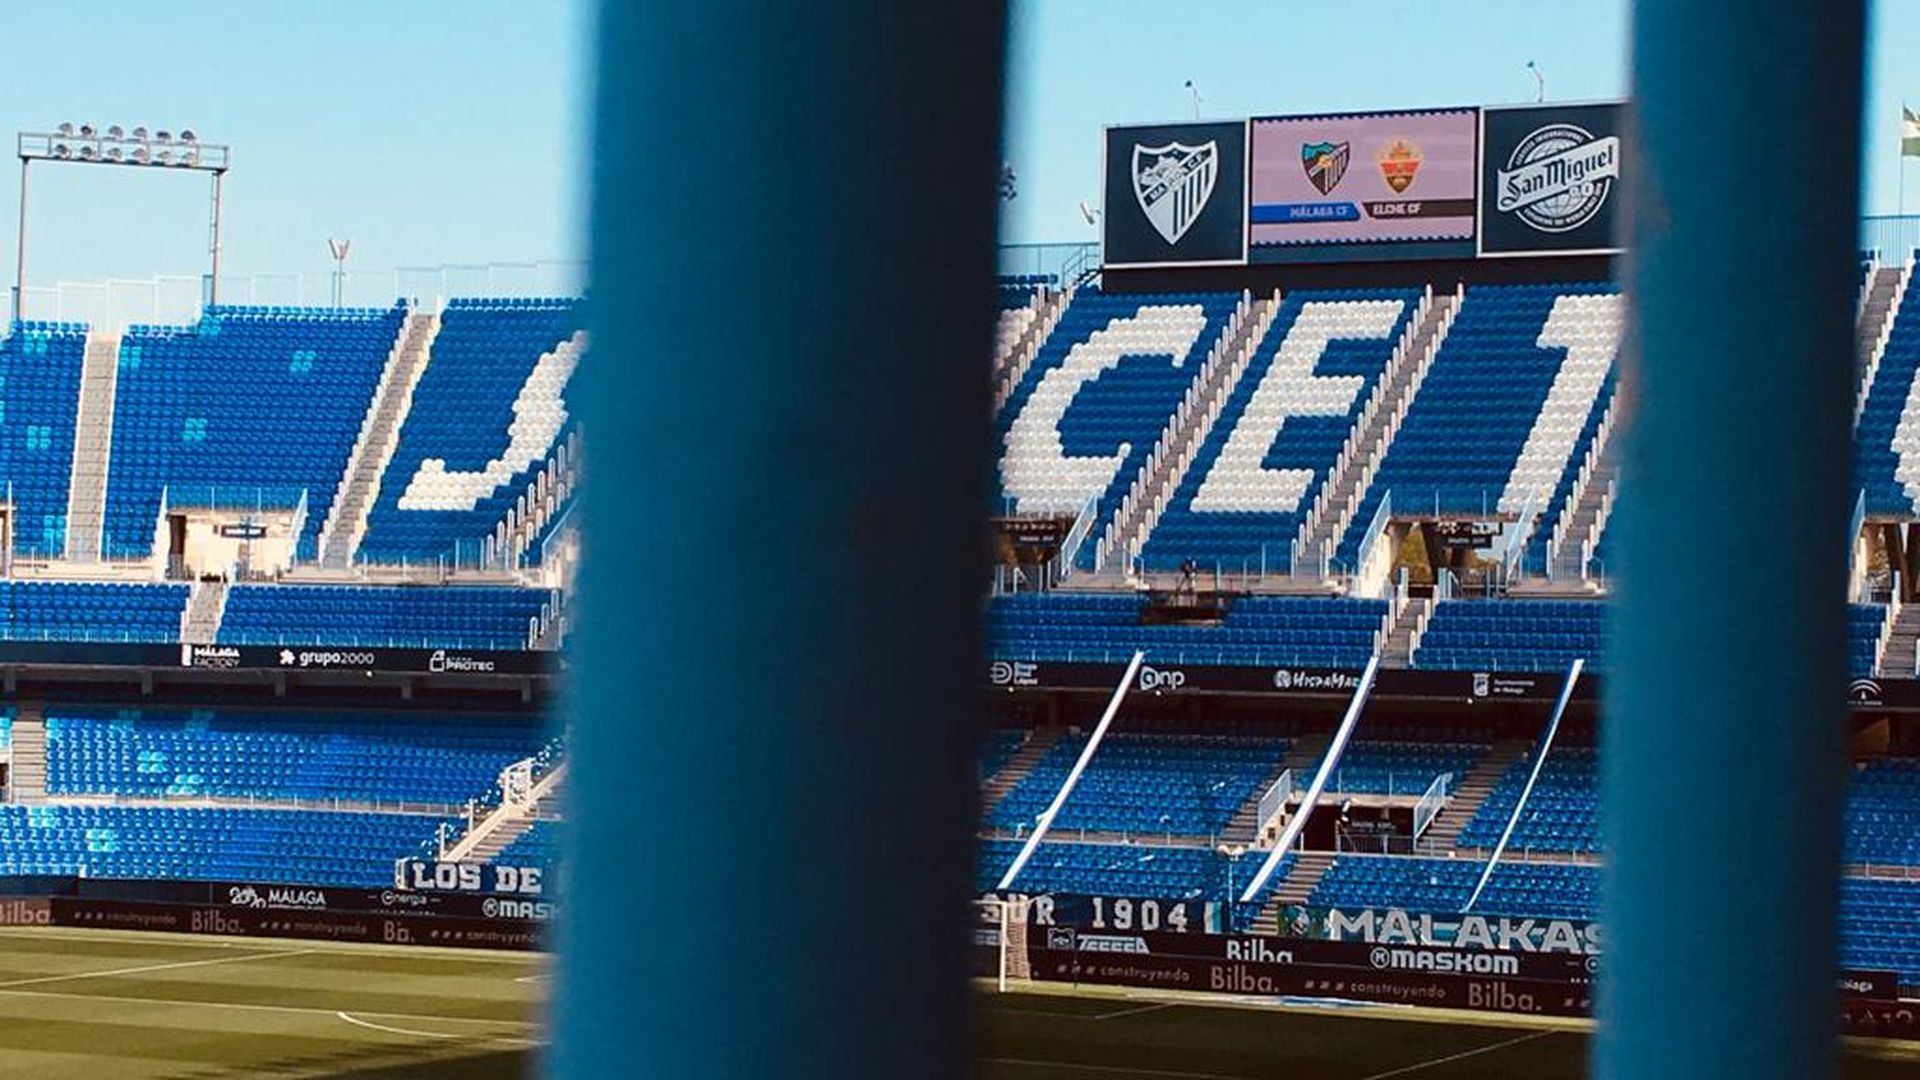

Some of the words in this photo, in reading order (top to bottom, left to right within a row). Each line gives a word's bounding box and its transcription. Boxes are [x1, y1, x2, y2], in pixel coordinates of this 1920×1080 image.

[412, 864, 482, 890] LOS
[494, 865, 542, 894] DE
[191, 910, 246, 934] Bilba.
[1092, 897, 1188, 933] 1904
[1390, 951, 1519, 975] MASKOM
[1211, 964, 1280, 993] Bilba.
[1351, 982, 1446, 999] construyendo
[1468, 982, 1542, 1012] Bilba.
